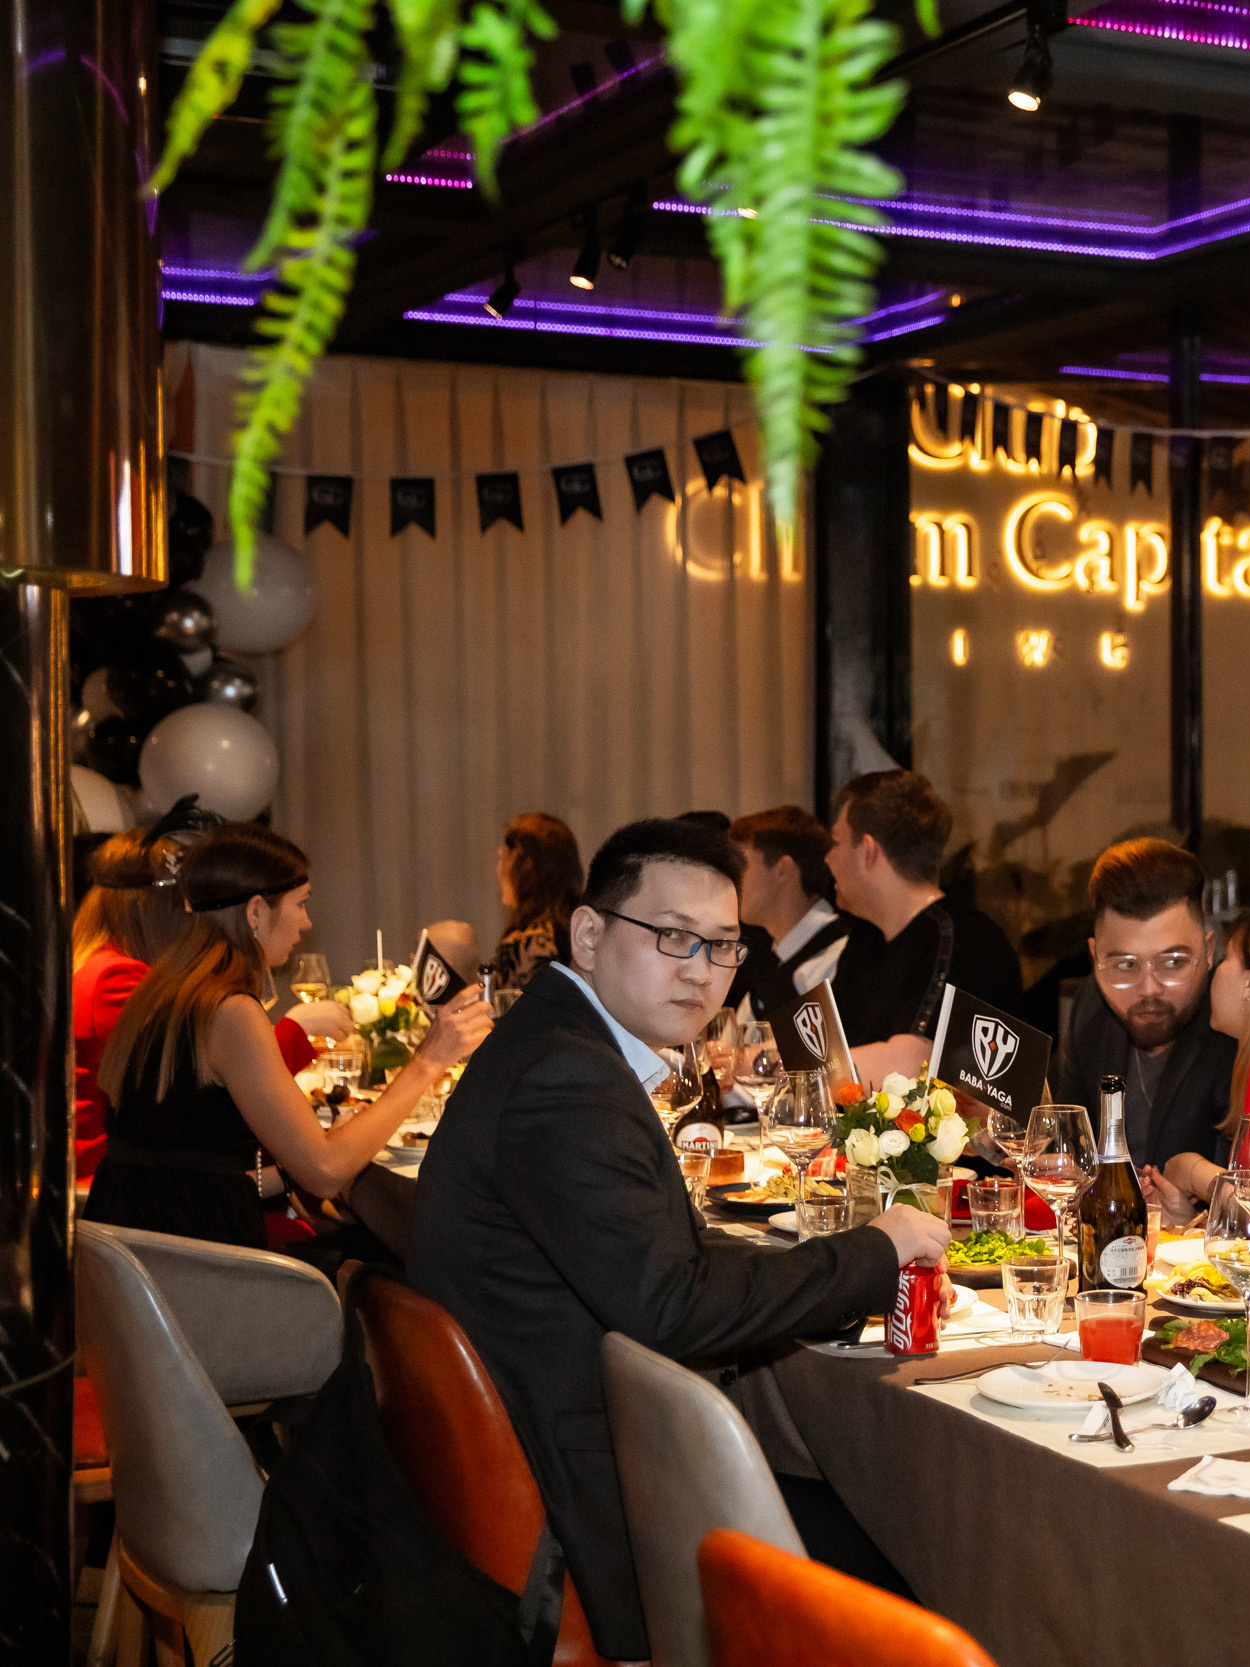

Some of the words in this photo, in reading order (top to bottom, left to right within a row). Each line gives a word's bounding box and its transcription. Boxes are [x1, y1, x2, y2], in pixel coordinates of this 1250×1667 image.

[976, 1021, 1018, 1079] BY
[960, 1069, 983, 1091] BABA
[987, 1083, 1013, 1107] YAGA
